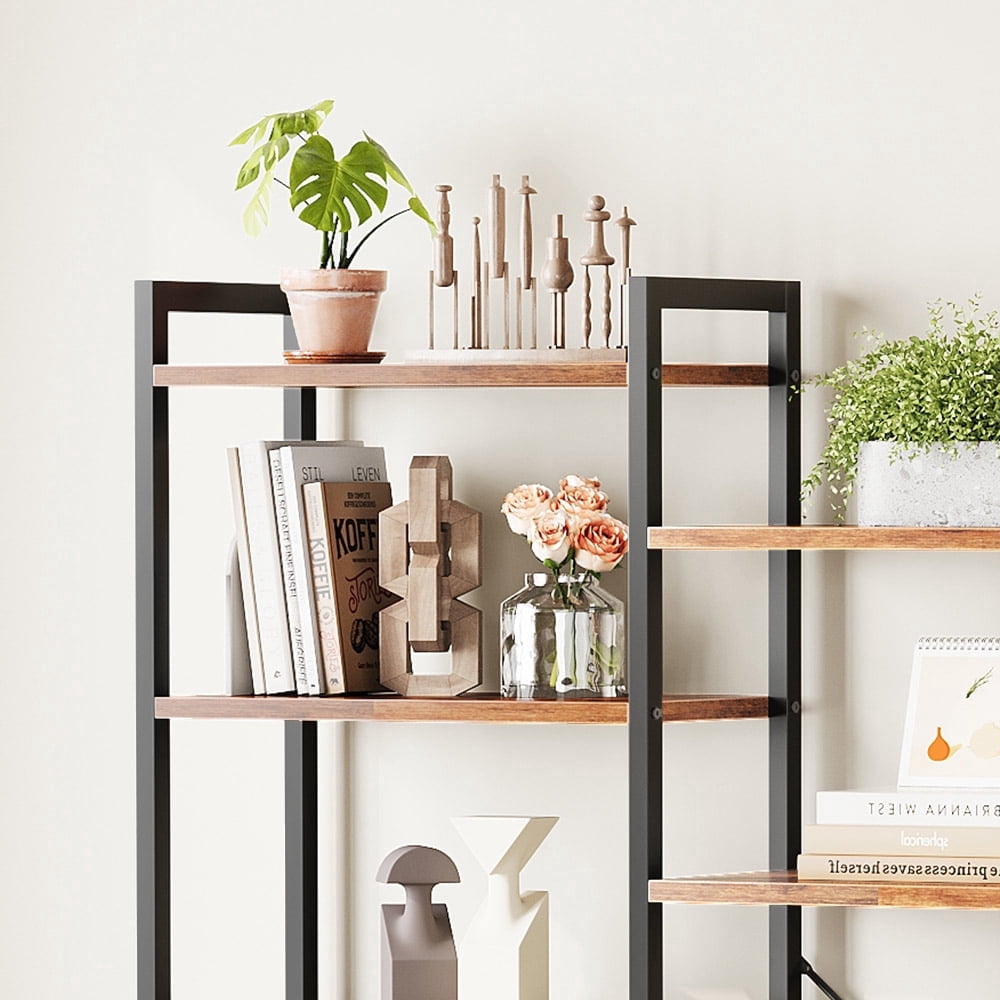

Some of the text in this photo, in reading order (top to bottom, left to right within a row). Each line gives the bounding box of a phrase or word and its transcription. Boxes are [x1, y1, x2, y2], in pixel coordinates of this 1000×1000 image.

[302, 466, 380, 481] STIL LEVEN
[333, 518, 378, 560] KOFF
[310, 538, 331, 601] KOFFIE
